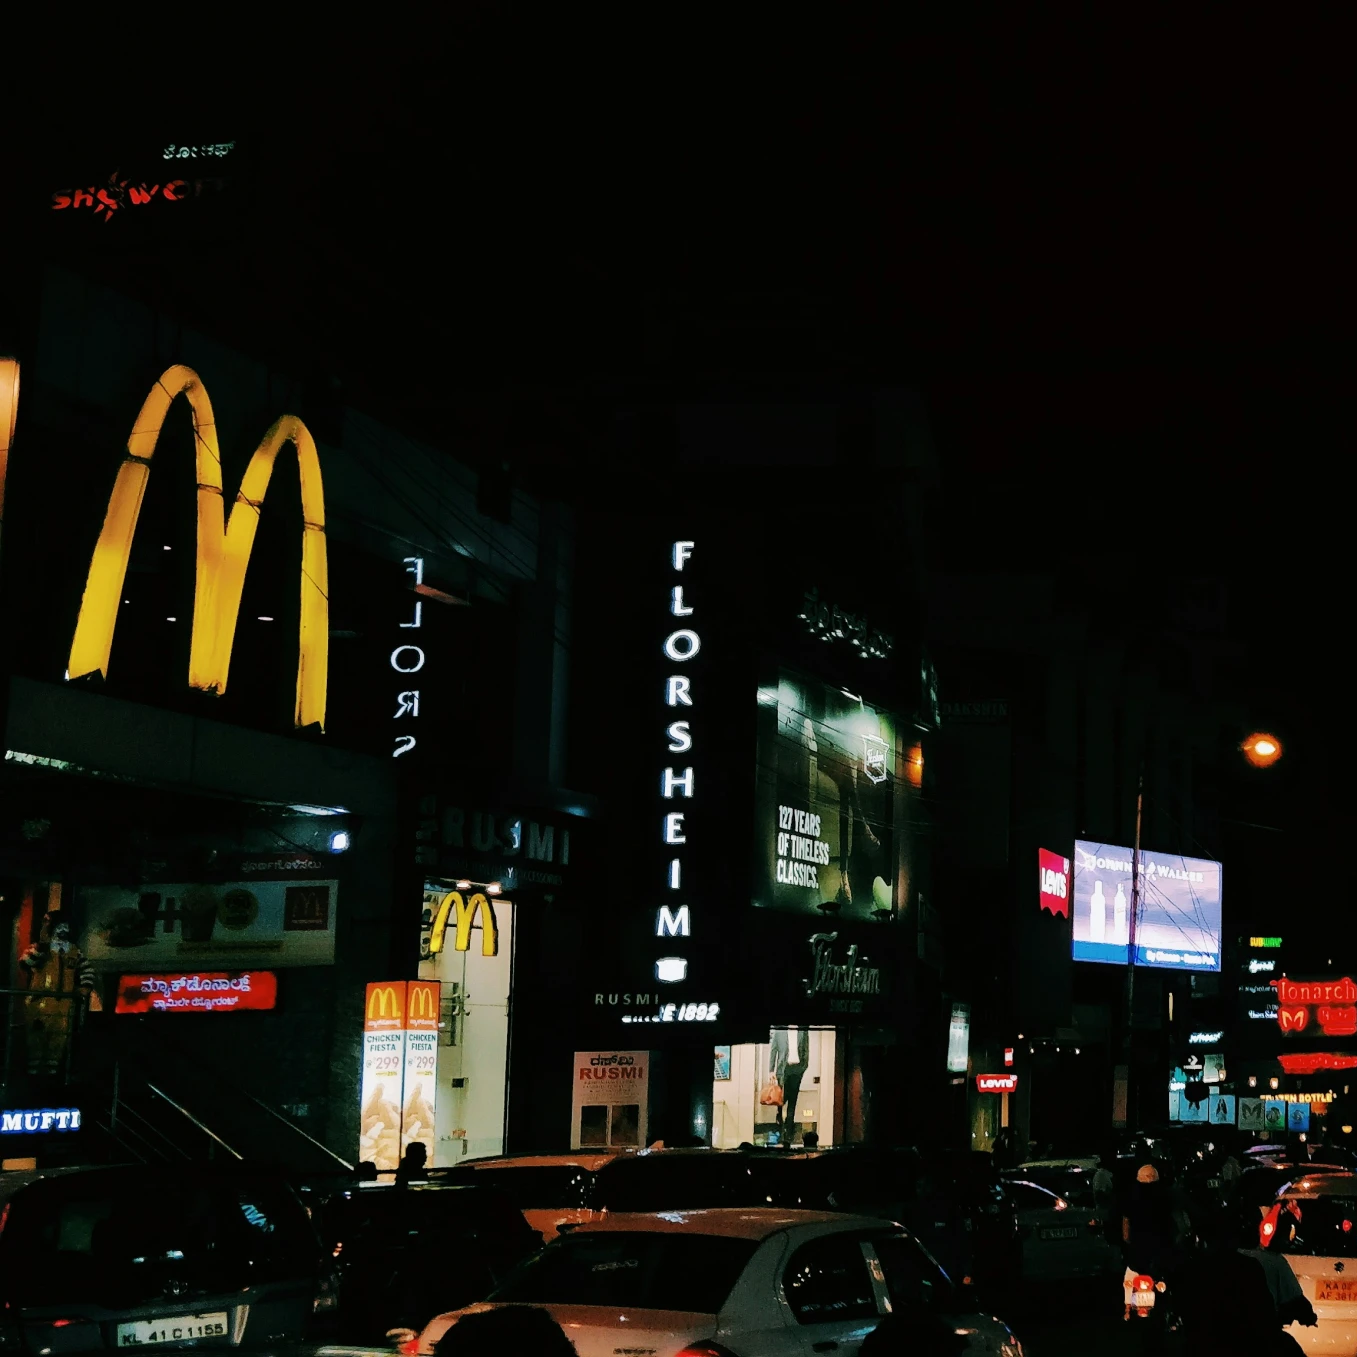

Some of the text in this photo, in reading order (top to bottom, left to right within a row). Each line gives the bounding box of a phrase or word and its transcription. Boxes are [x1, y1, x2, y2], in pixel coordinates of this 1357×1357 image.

[657, 540, 702, 937] FLORSHEIM
[778, 805, 821, 838] 127 YEARS
[777, 832, 830, 866] OF TIMELESS
[776, 858, 819, 889] CLASSICS.
[1156, 865, 1204, 883] WALKER
[594, 993, 659, 1005] RUSMI
[677, 1002, 720, 1022] 1892
[367, 1034, 401, 1043] CHICKEN
[370, 1044, 396, 1052] FIESTA
[411, 1043, 432, 1051] FIESTA
[579, 1067, 643, 1080] RUSMI
[1, 1108, 81, 1133] MUFTI
[1325, 1282, 1339, 1290] KA
[123, 1323, 223, 1344] KL 41 C 1155
